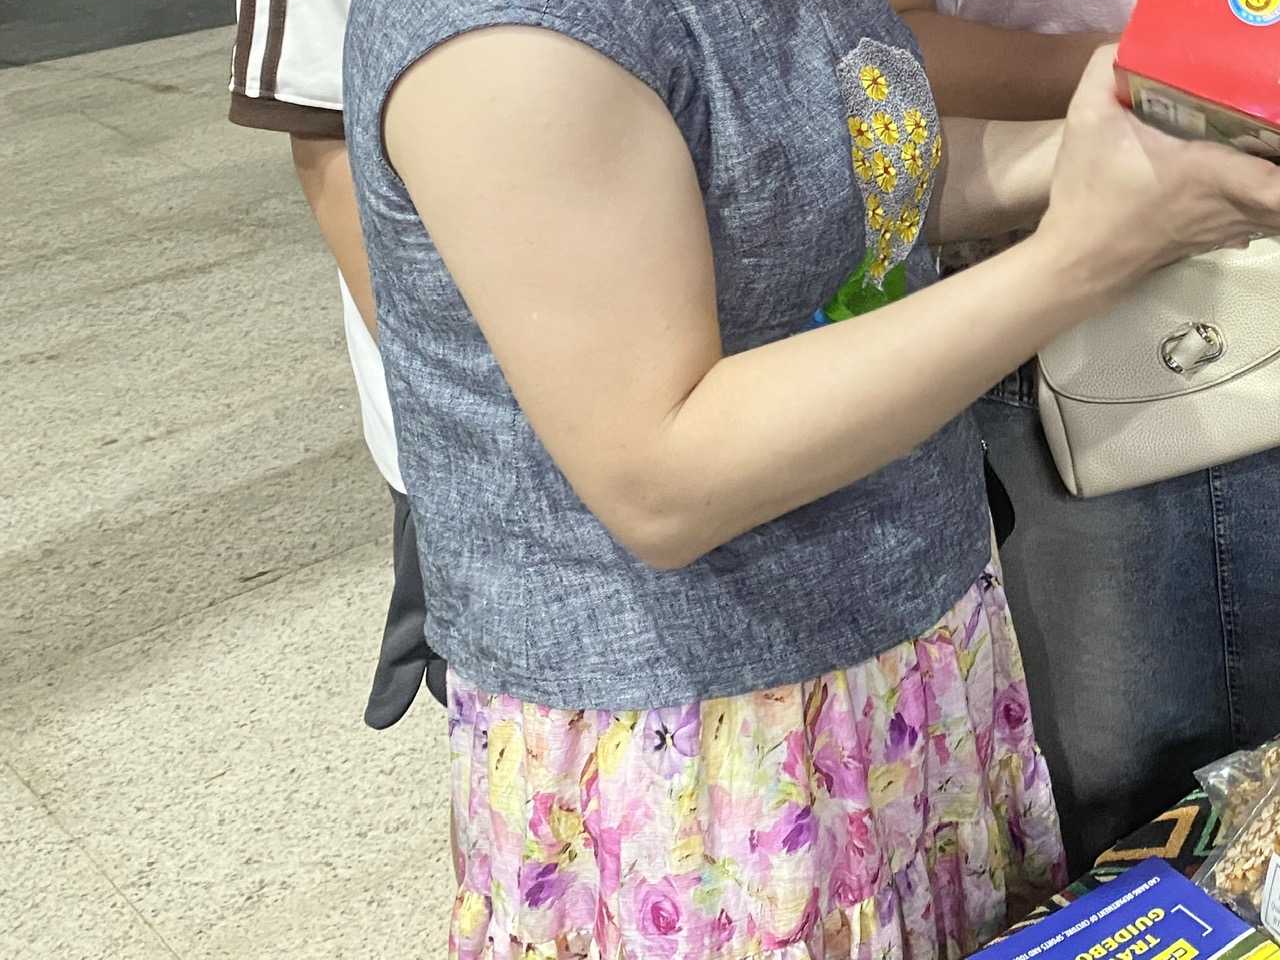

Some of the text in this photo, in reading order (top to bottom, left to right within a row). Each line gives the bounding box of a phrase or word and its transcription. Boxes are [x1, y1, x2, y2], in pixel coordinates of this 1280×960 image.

[1132, 884, 1150, 897] BANG
[1097, 892, 1134, 919] DEPARTMENT
[1089, 915, 1099, 924] OF
[1040, 934, 1064, 951] SPORTS
[1108, 934, 1161, 960] TRA
[1029, 946, 1042, 957] AND
